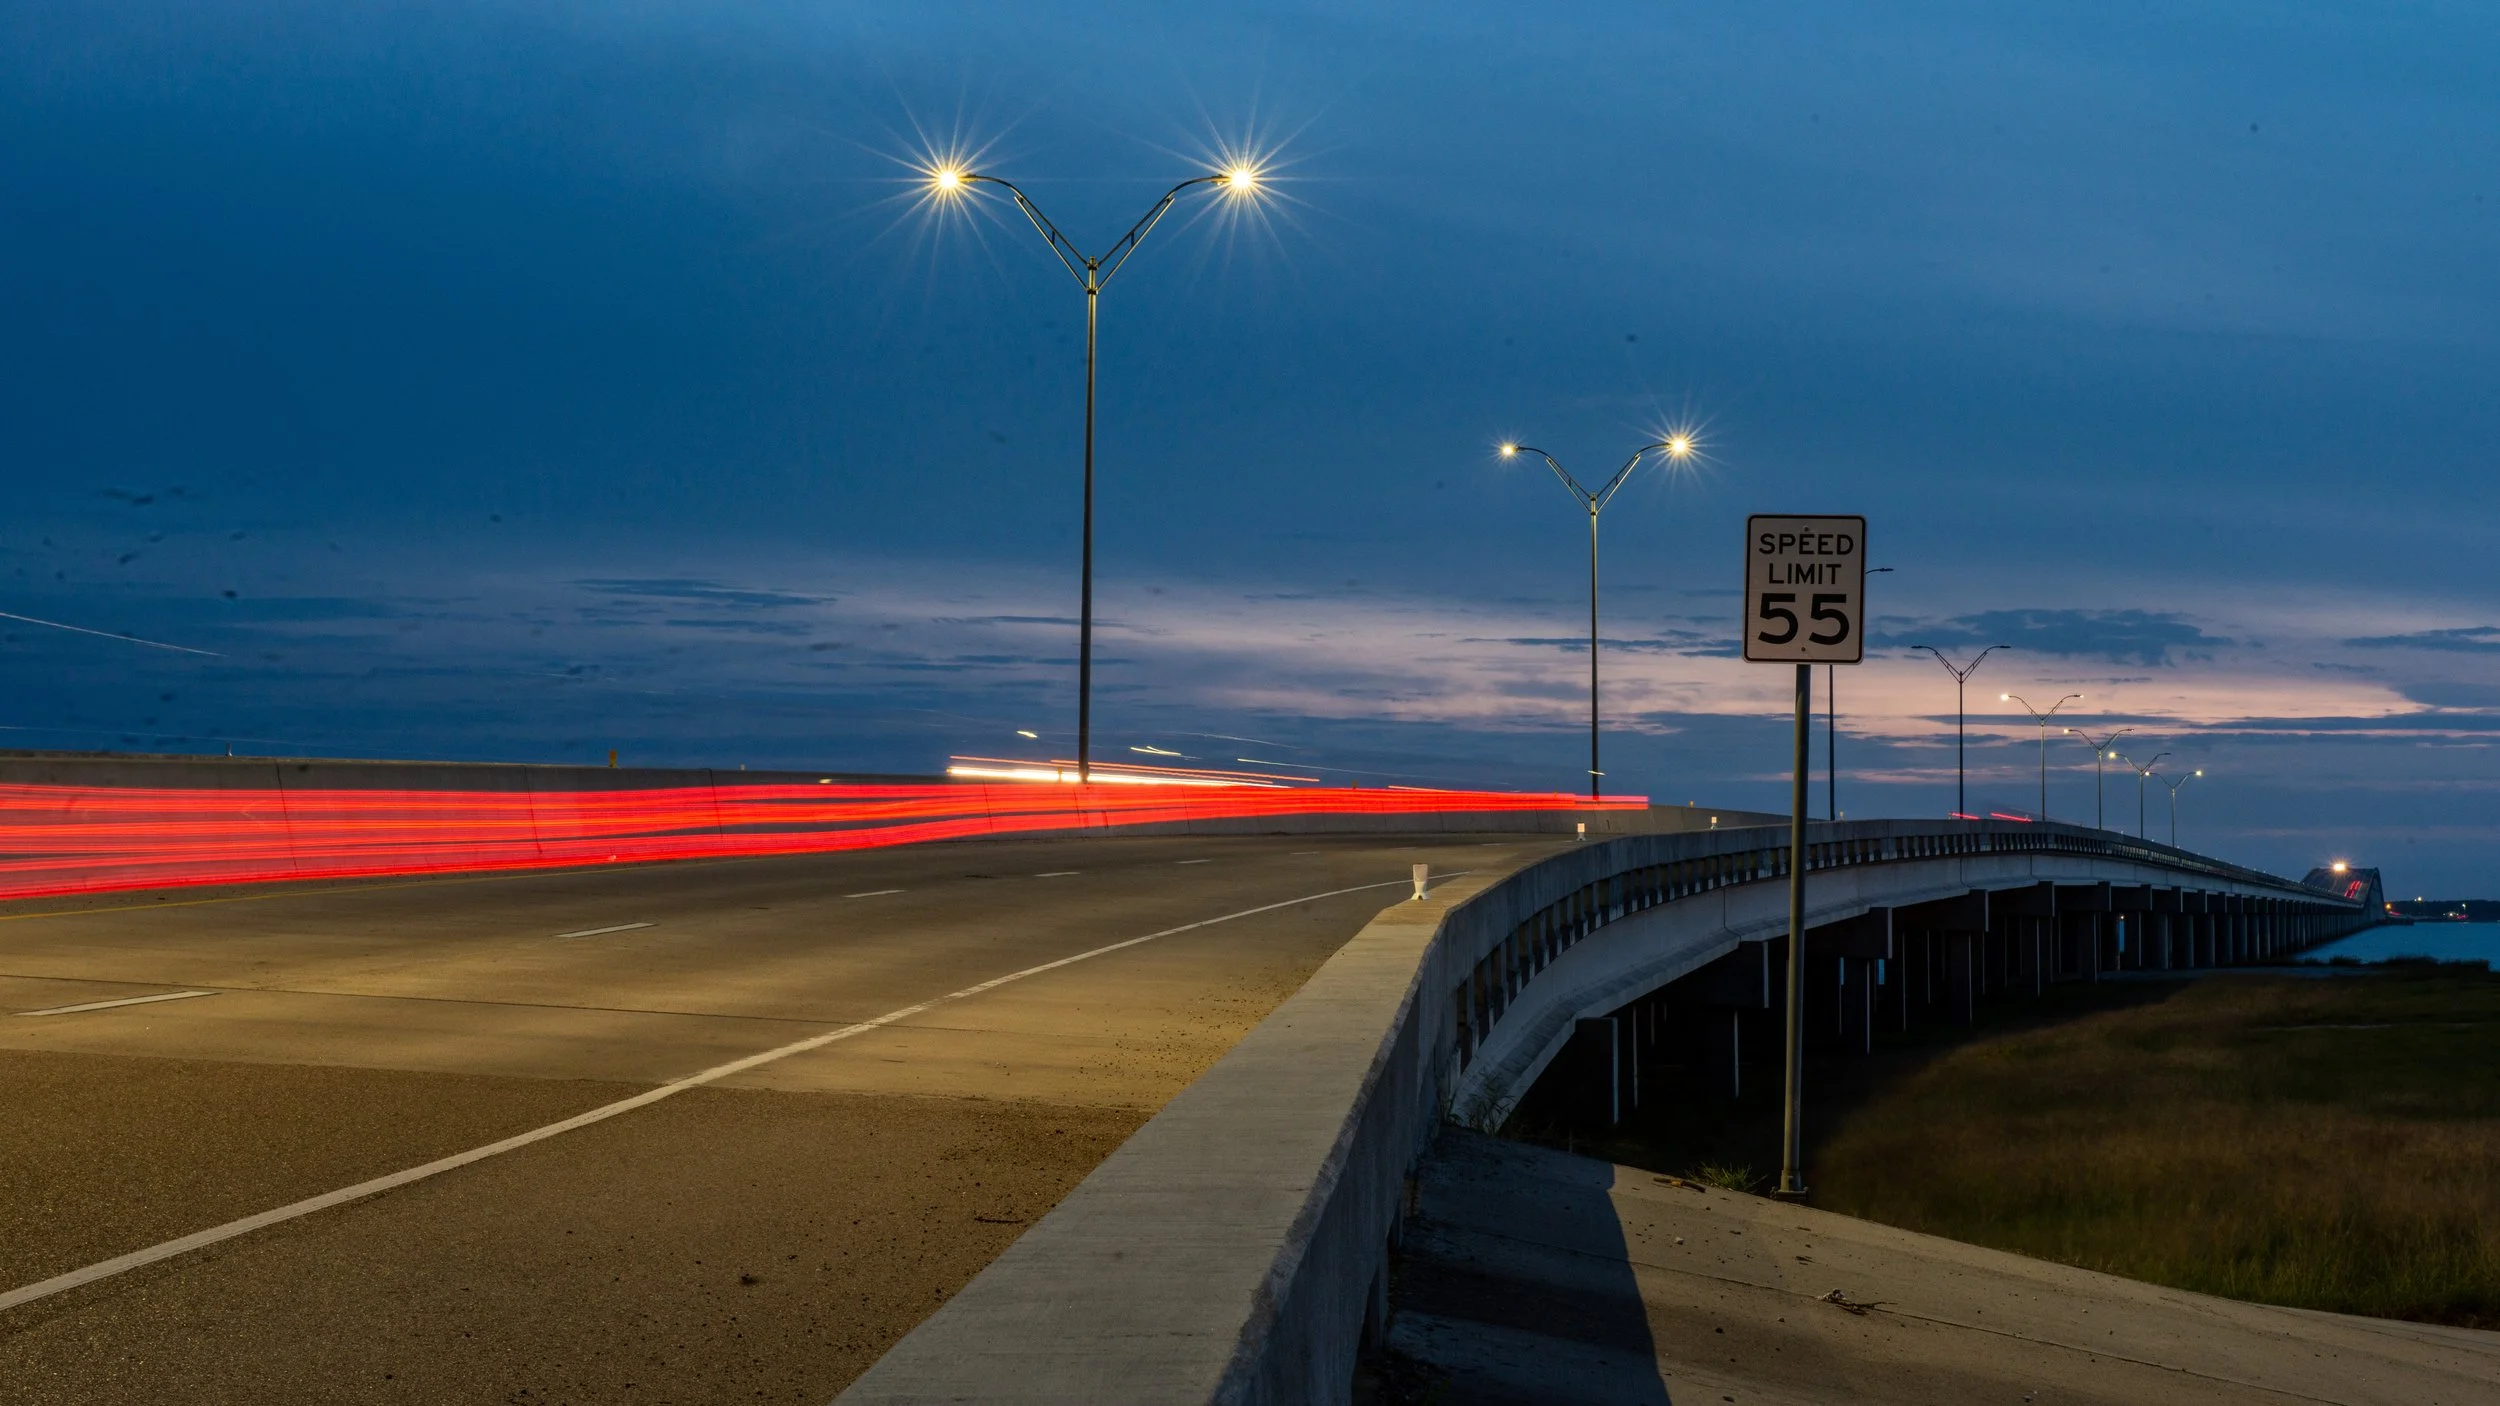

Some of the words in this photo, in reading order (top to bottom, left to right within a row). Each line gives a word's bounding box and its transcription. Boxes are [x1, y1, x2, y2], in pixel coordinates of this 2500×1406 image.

[1759, 532, 1854, 555] SPEED
[1768, 562, 1842, 585] LIMIT
[1757, 592, 1850, 646] 55
